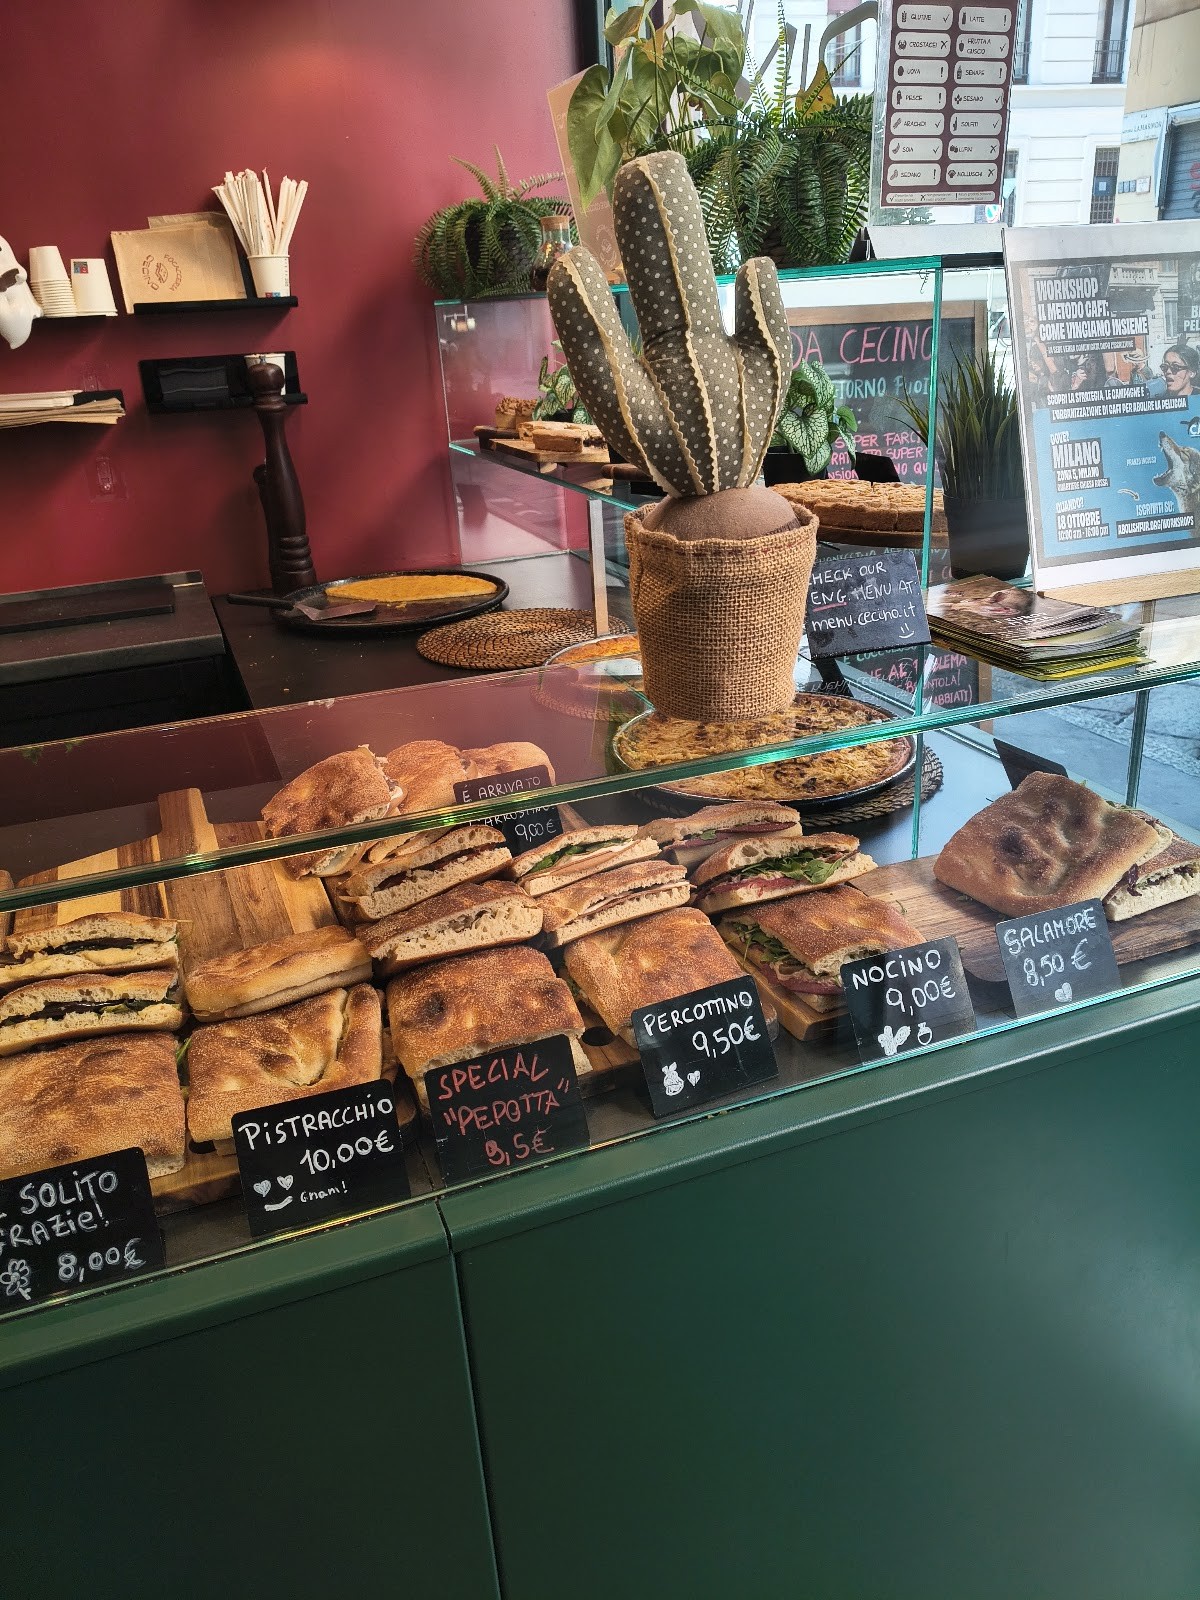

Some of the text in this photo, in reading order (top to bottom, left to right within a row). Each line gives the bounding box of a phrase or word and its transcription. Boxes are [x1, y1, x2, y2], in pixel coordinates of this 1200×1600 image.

[1036, 278, 1099, 301] WORKSHOP
[1038, 303, 1047, 321] IL
[1047, 301, 1084, 320] METODO
[1040, 316, 1148, 341] COME VINCIAMO INSIEME
[1047, 393, 1068, 405] SCOPRI
[1068, 392, 1075, 404] LA
[1105, 389, 1112, 400] LE
[1111, 387, 1141, 399] CAMPAGNE
[1122, 402, 1133, 413] PER
[1133, 400, 1155, 412] ABOLIRE
[835, 431, 880, 449] SPER
[1052, 441, 1100, 468] MILANO
[1057, 468, 1073, 481] ZONA
[1078, 466, 1099, 479] MILANO
[1057, 511, 1100, 530] 18 OTTOBRE
[808, 561, 887, 586] HECK OUR
[478, 776, 541, 800] ARRIVATO
[1004, 907, 1098, 955] SALAMORE
[643, 991, 753, 1037] PERCOTTINO
[692, 1016, 762, 1059] 9,50€
[439, 1053, 549, 1100] SPECIAL
[300, 1130, 395, 1175] 10,00€
[57, 1237, 147, 1283] 8,00€
